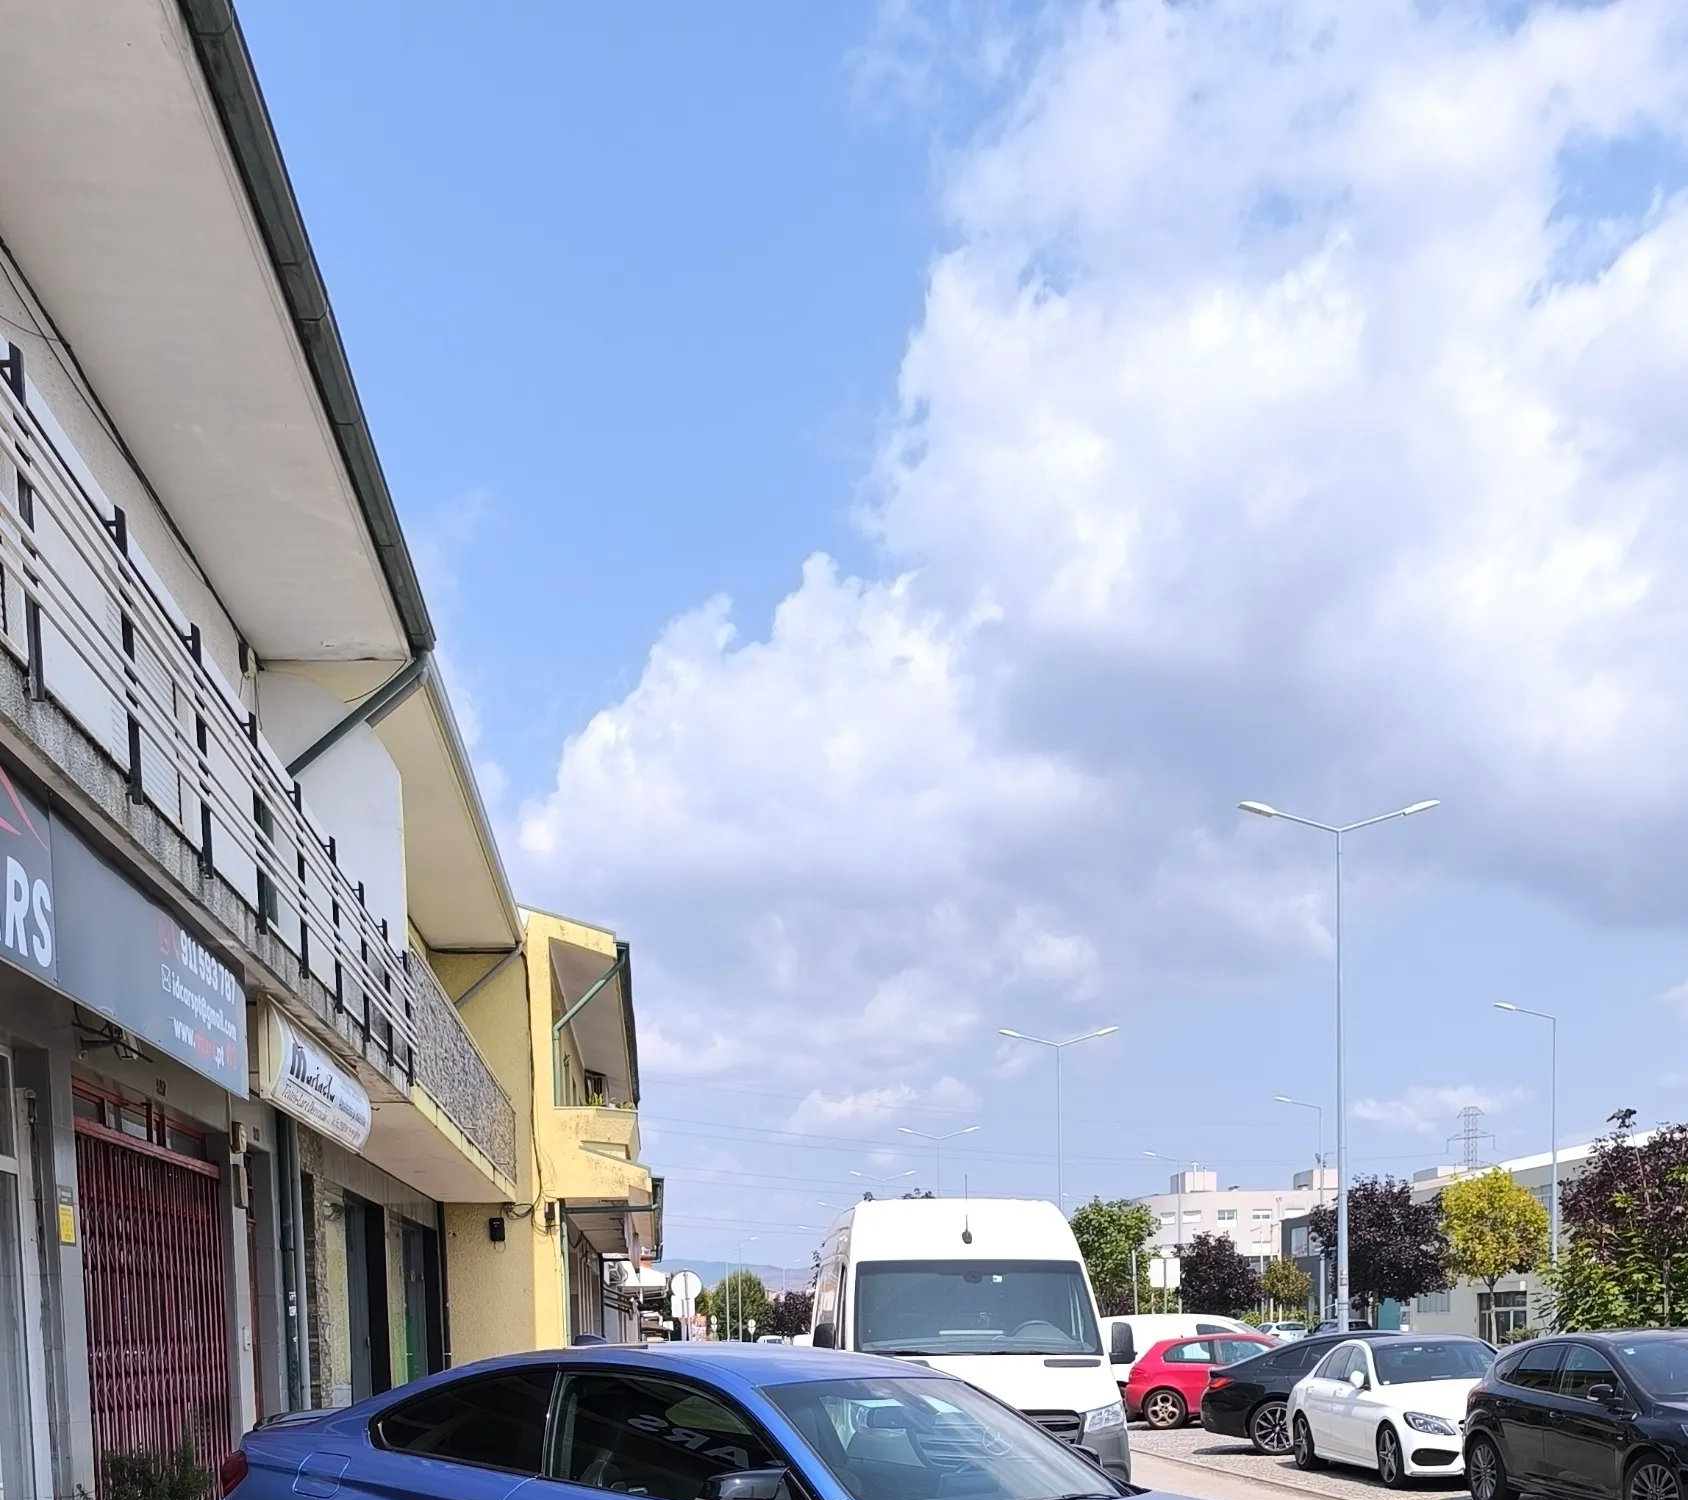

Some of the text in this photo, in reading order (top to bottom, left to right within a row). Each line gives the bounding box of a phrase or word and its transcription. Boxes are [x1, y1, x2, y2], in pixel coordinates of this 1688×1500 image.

[0, 855, 53, 968] RS
[180, 929, 198, 974] 911
[198, 945, 218, 992] 593
[171, 971, 237, 1042] idcarspt@gmail.com
